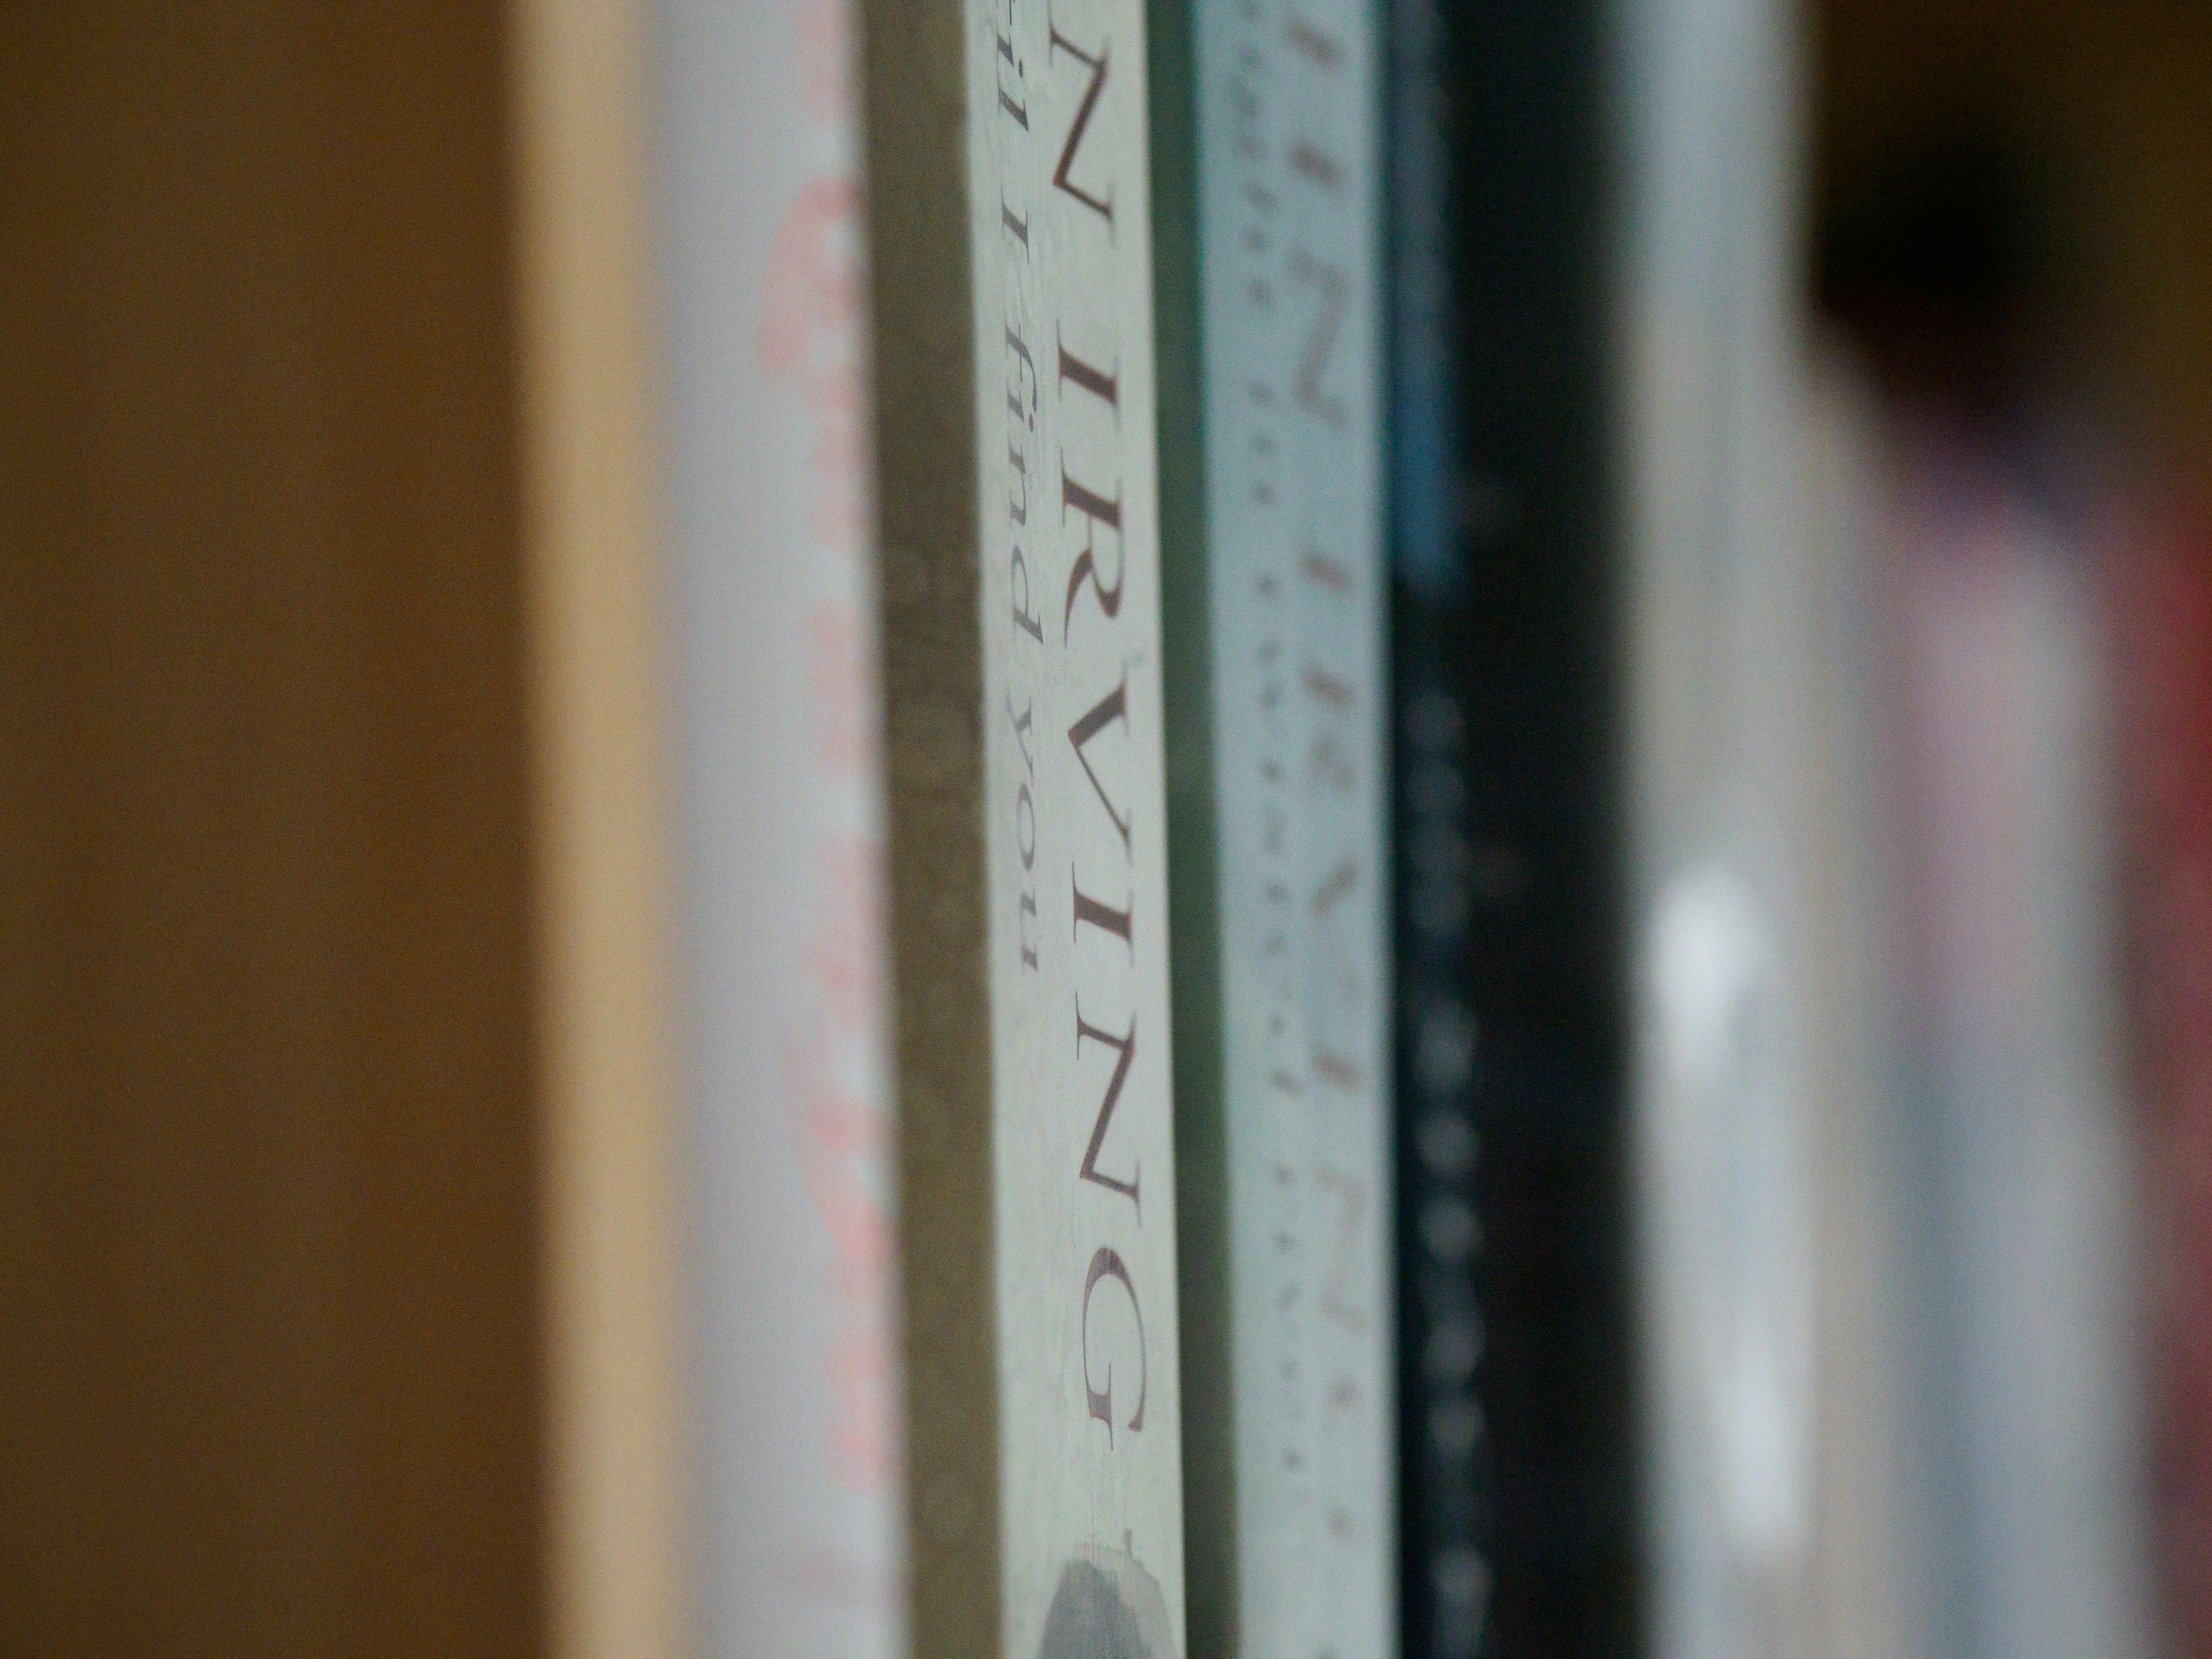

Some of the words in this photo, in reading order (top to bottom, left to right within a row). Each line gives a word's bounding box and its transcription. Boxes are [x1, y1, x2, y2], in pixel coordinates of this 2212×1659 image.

[1001, 186, 1030, 265] I
[1046, 0, 1117, 247] N
[1005, 318, 1044, 645] find
[1005, 685, 1038, 972] you
[1055, 318, 1147, 1451] IRVING
